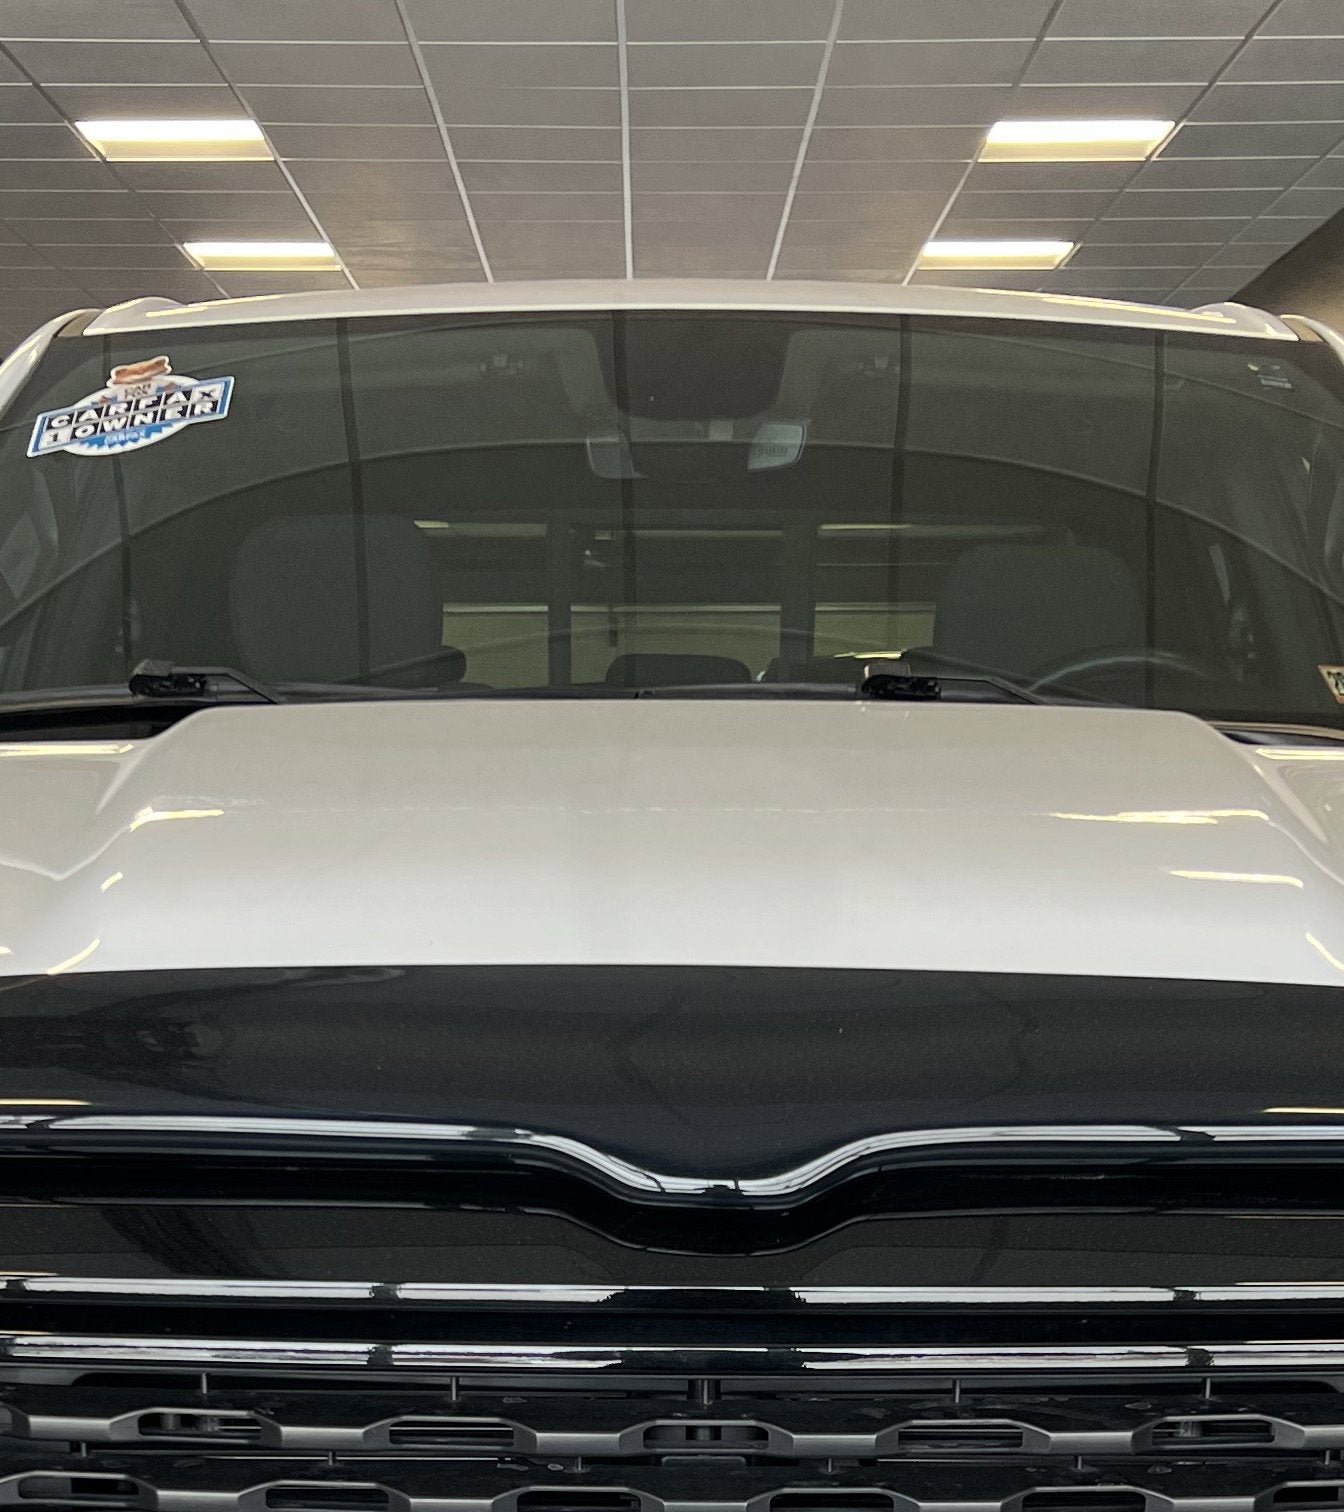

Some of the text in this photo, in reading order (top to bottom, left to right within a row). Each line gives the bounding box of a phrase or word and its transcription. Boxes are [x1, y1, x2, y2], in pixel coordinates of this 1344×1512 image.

[45, 402, 215, 444] 1 OWNER
[50, 388, 218, 429] CARFAX
